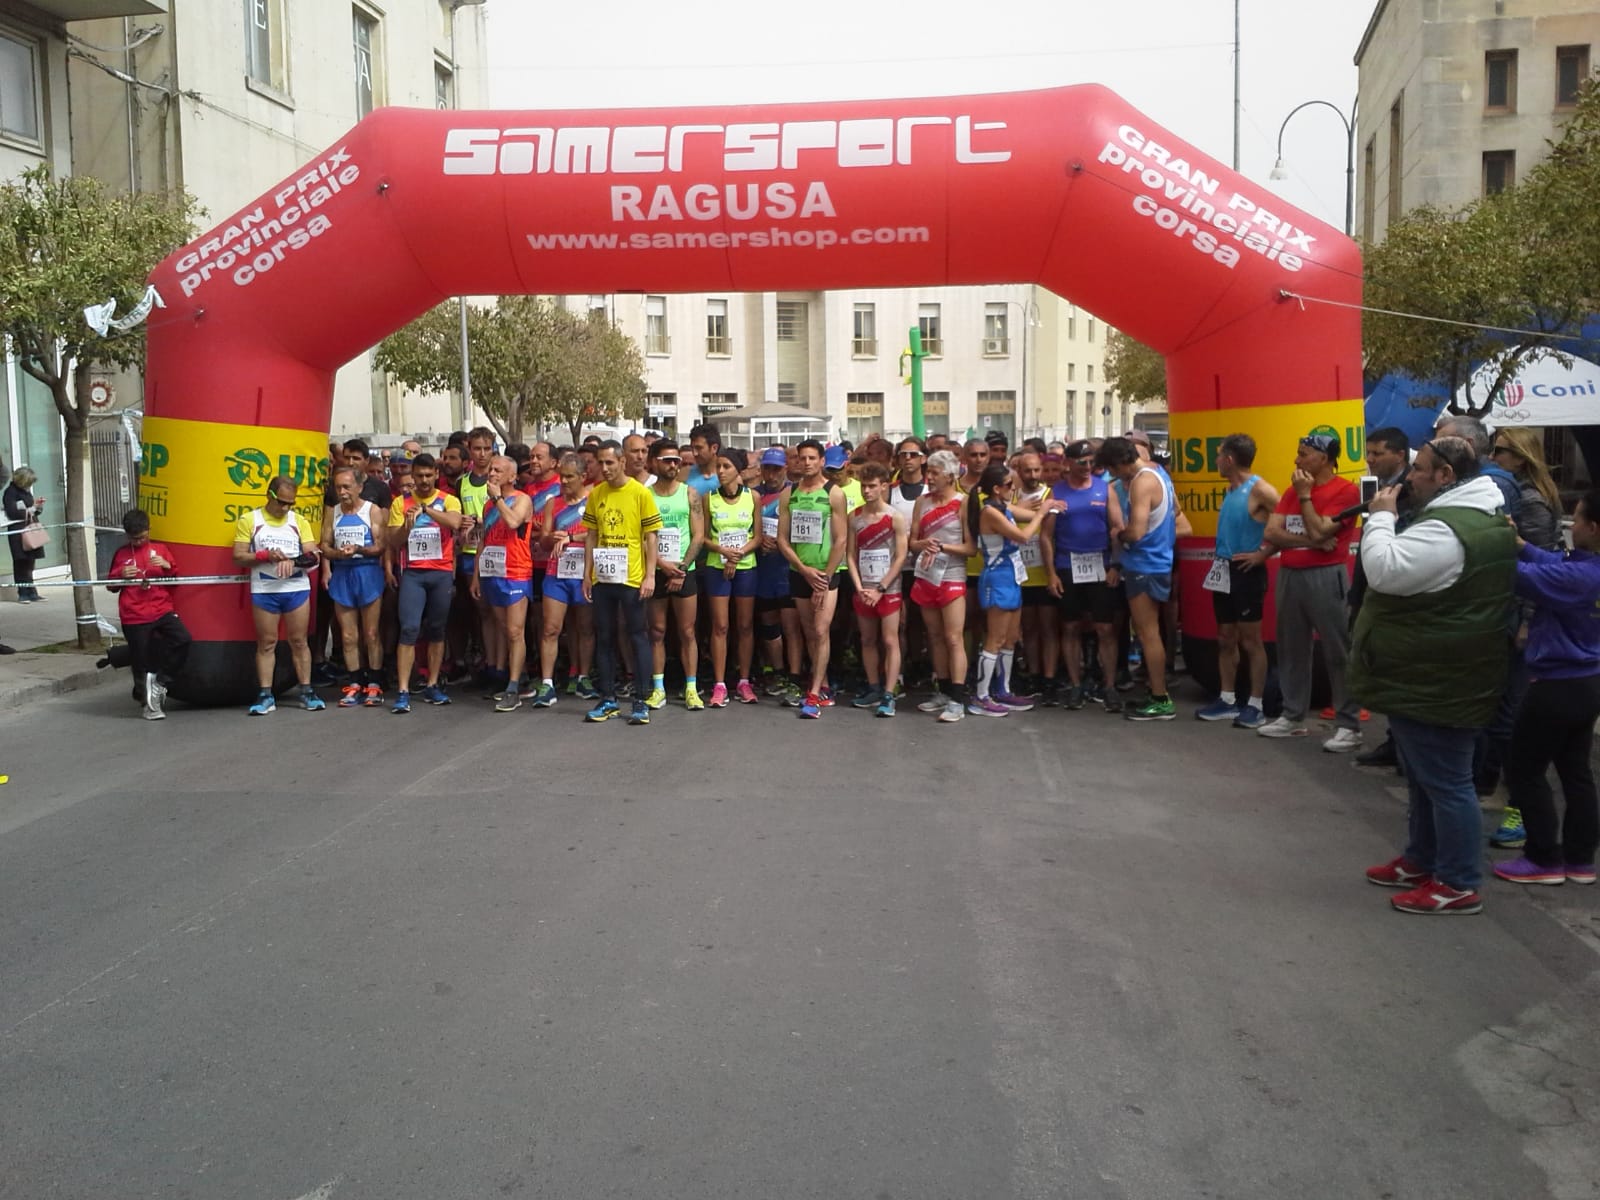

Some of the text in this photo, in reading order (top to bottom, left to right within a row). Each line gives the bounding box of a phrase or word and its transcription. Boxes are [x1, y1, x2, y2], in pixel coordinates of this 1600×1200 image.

[1118, 124, 1317, 254] GRAN PRIX
[175, 146, 351, 273] GRAN PRIX
[610, 181, 837, 221] RAGUSA
[1097, 142, 1304, 272] provinciale
[179, 164, 360, 298] provinciale
[526, 225, 930, 251] www.samershop.com
[1132, 193, 1240, 270] corsa
[233, 212, 333, 286] corsa
[1531, 380, 1596, 397] Coni
[796, 524, 811, 535] 181
[416, 541, 428, 552] 79
[658, 542, 670, 553] 05
[565, 560, 577, 571] 78
[598, 563, 616, 574] 218
[868, 564, 874, 574] 1
[1077, 564, 1093, 574] 101
